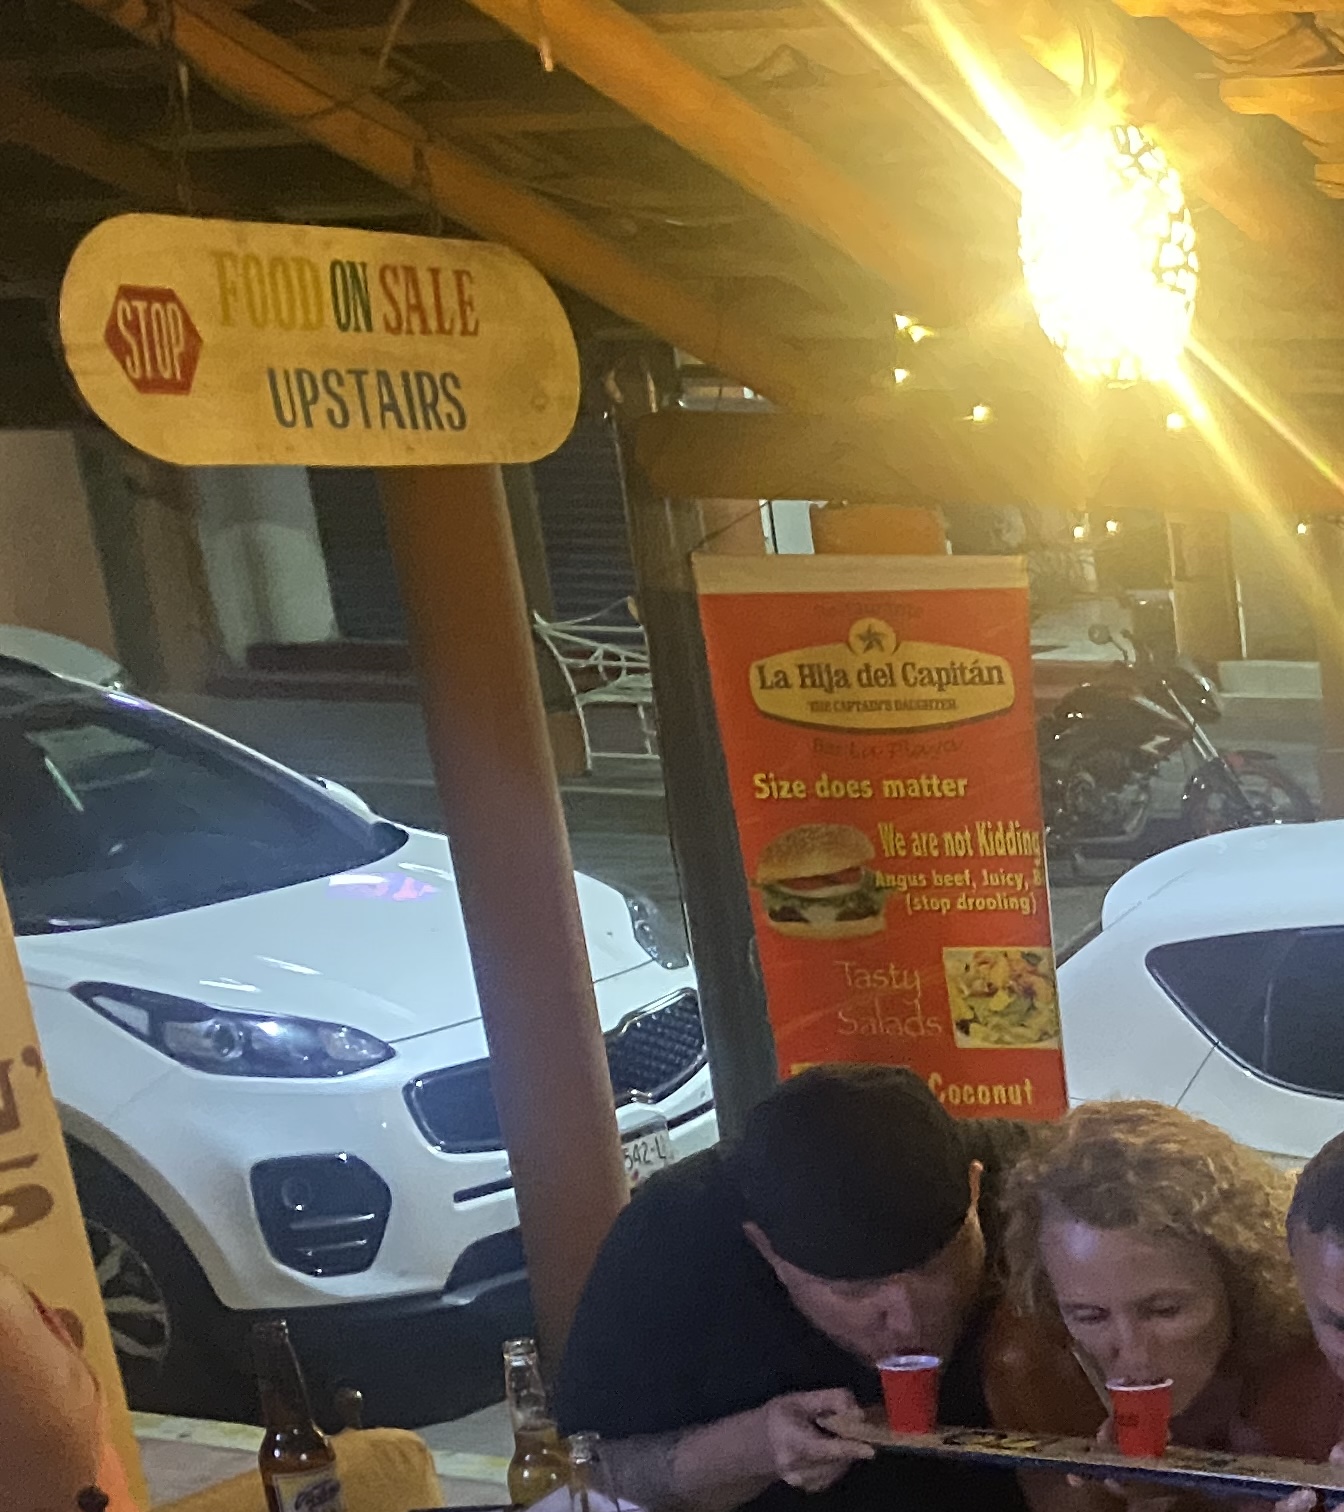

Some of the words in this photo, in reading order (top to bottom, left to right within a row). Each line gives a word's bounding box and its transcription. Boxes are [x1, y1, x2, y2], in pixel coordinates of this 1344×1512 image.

[214, 251, 326, 331] FOOD
[330, 260, 372, 333] ON
[382, 266, 479, 338] SALE
[117, 299, 183, 382] STOP
[268, 366, 468, 431] UPSTAIRS
[757, 665, 791, 689] La
[857, 662, 894, 688] del
[902, 659, 1005, 692] Capitán
[753, 773, 806, 799] Size
[816, 773, 873, 798] does
[883, 776, 968, 798] matter
[878, 821, 905, 857] We
[910, 831, 938, 856] are
[942, 825, 972, 856] not
[975, 820, 1040, 866] Kidding
[875, 869, 926, 890] Angus
[906, 891, 950, 915] (stop
[957, 891, 1036, 914] drooling)
[834, 960, 922, 1009] Tasty
[838, 995, 942, 1037] Salads
